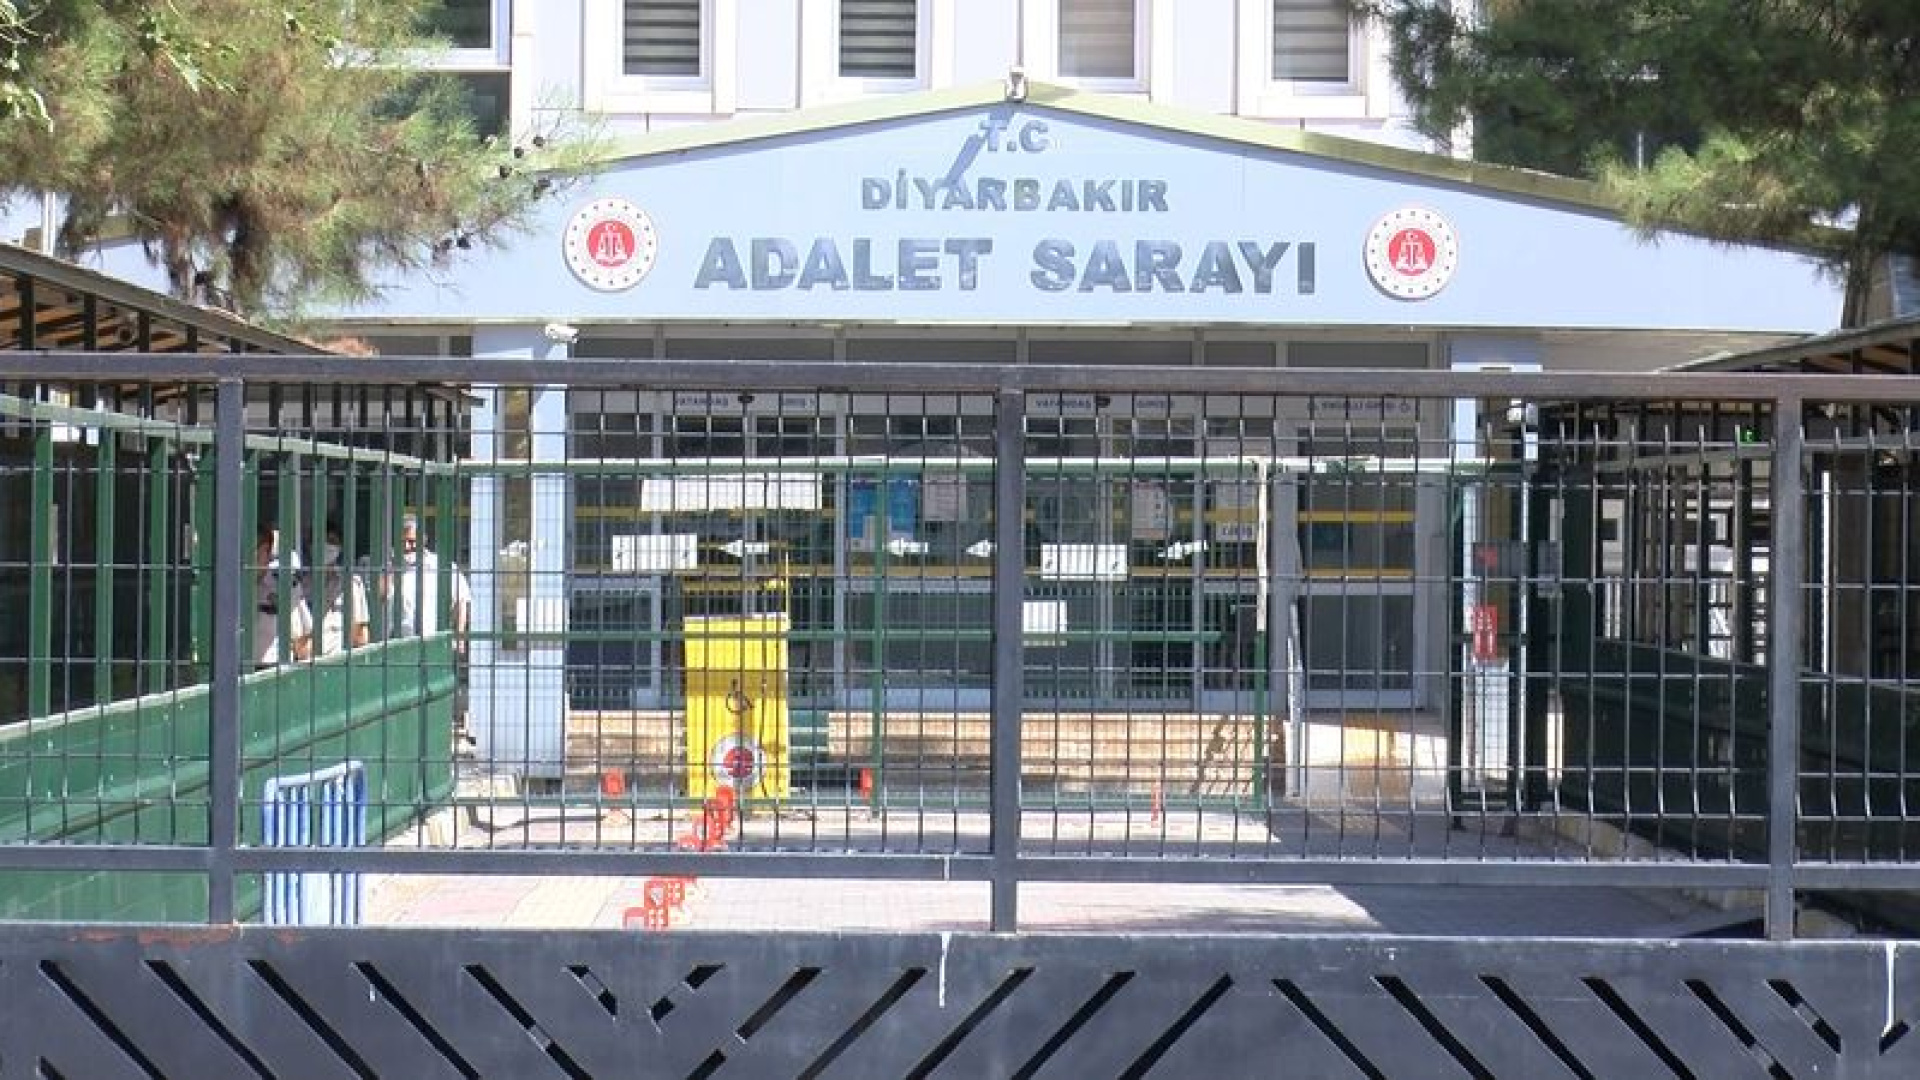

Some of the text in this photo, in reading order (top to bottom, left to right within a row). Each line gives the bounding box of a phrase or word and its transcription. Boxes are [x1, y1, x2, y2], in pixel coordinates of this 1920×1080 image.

[862, 168, 1168, 212] DİYARBAKIR
[694, 237, 1315, 294] ADALET SARAYI
